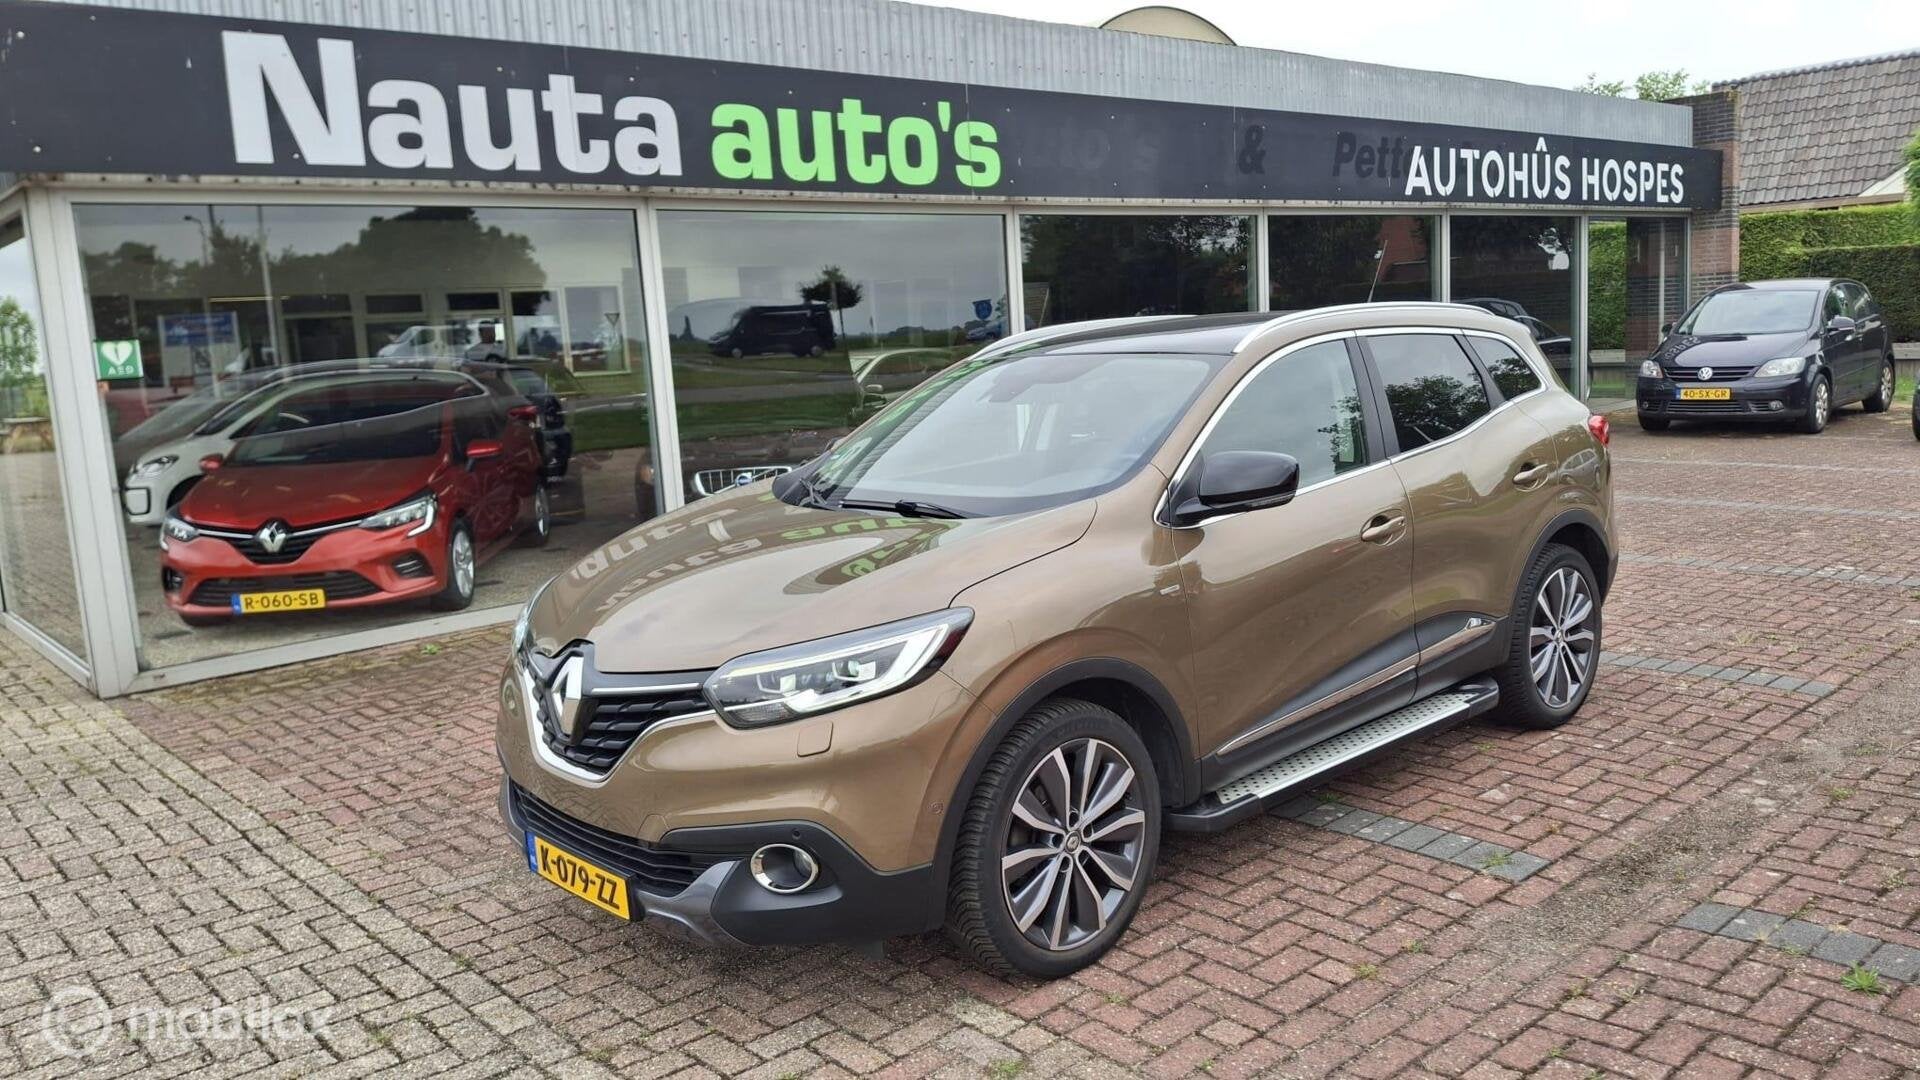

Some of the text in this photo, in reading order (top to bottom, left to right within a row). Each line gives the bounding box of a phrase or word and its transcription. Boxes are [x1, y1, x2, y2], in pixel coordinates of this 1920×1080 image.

[221, 30, 683, 176] Nauta
[711, 98, 1001, 188] auto's
[1404, 136, 1685, 204] AUTOHÛS HOSPES
[1682, 389, 1728, 399] 40-SX-GR
[244, 592, 320, 610] R-060-SB
[540, 844, 621, 910] K-079-ZZ
